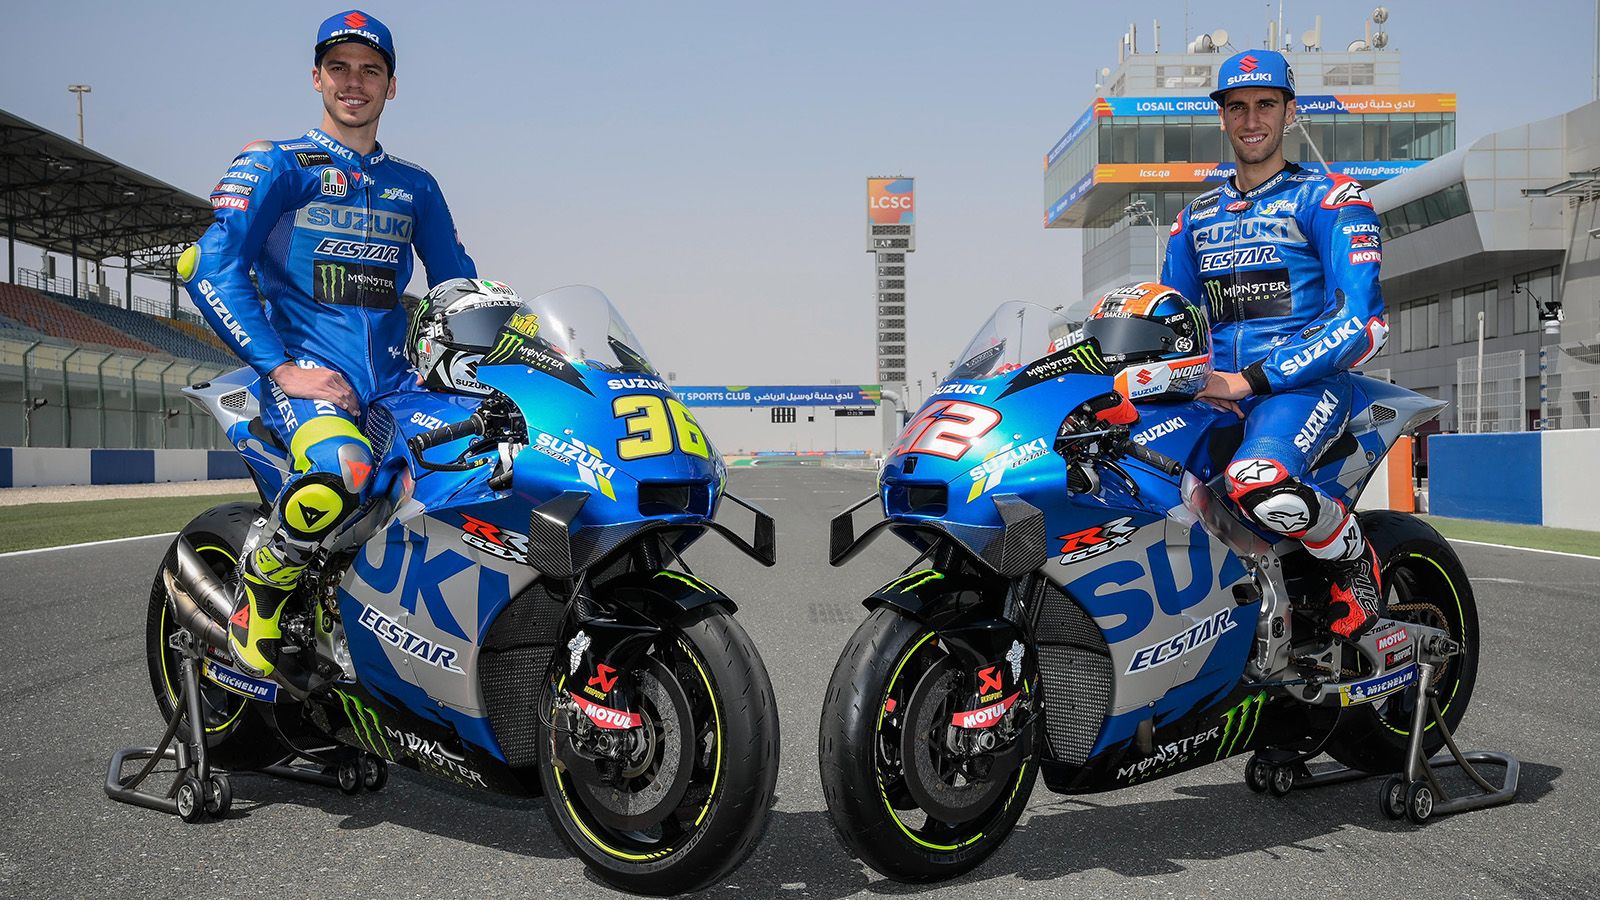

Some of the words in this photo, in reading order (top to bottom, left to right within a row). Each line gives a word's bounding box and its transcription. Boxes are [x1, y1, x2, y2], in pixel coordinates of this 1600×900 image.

[1227, 73, 1272, 85] SUZUKI
[1136, 101, 1175, 111] LOSAIL
[1337, 100, 1368, 111] لوسيل
[1370, 99, 1393, 110] حلبة
[1394, 100, 1415, 112] نادي
[306, 130, 354, 160] SUZUKI
[1139, 169, 1170, 178] lcsc.qa
[323, 183, 344, 196] agv
[871, 196, 911, 209] LCSC
[307, 206, 412, 238] SUZUKI
[874, 240, 892, 248] LAP
[1196, 222, 1289, 248] SUZUKI
[313, 238, 400, 263] ECSTAR
[1201, 245, 1282, 272] ECSTAR
[348, 273, 394, 289] MONSTER
[1223, 281, 1289, 298] MONSTER
[197, 279, 252, 348] SUZUKI
[1280, 315, 1365, 376] SUZUKI
[518, 344, 566, 371] MONSTER
[520, 356, 553, 372] ENERGY
[1027, 355, 1078, 377] MONSTER
[880, 373, 888, 381] 10
[1039, 365, 1074, 379] ENERGY
[687, 392, 723, 401] SPORTS
[725, 392, 751, 401] CLUB
[753, 392, 785, 403] الرياضي
[786, 392, 813, 402] لوسيل
[814, 391, 834, 400] حلبة
[835, 392, 854, 402] نادي
[1131, 384, 1163, 398] SUZUKI
[611, 393, 711, 463] 36
[1132, 415, 1187, 446] SUZUKI
[1294, 389, 1339, 453] SUZUKI
[531, 443, 573, 467] ECSTAR
[535, 432, 617, 480] SUZUKI
[970, 437, 1048, 481] SUZUKI
[1010, 448, 1051, 469] ECSTAR
[461, 531, 528, 564] GSX
[1060, 530, 1131, 565] GSX
[1371, 621, 1396, 634] TAICHI
[357, 604, 467, 676] ECSTAR
[1124, 607, 1239, 676] ECSTAR
[1379, 630, 1407, 650] MOTUL
[218, 671, 269, 696] MICHELIN
[1366, 670, 1413, 695] MICHELIN
[585, 703, 632, 729] MOTUL
[963, 703, 1007, 728] MOTUL
[384, 725, 488, 788] MONSTER
[1116, 726, 1219, 779] MONSTER
